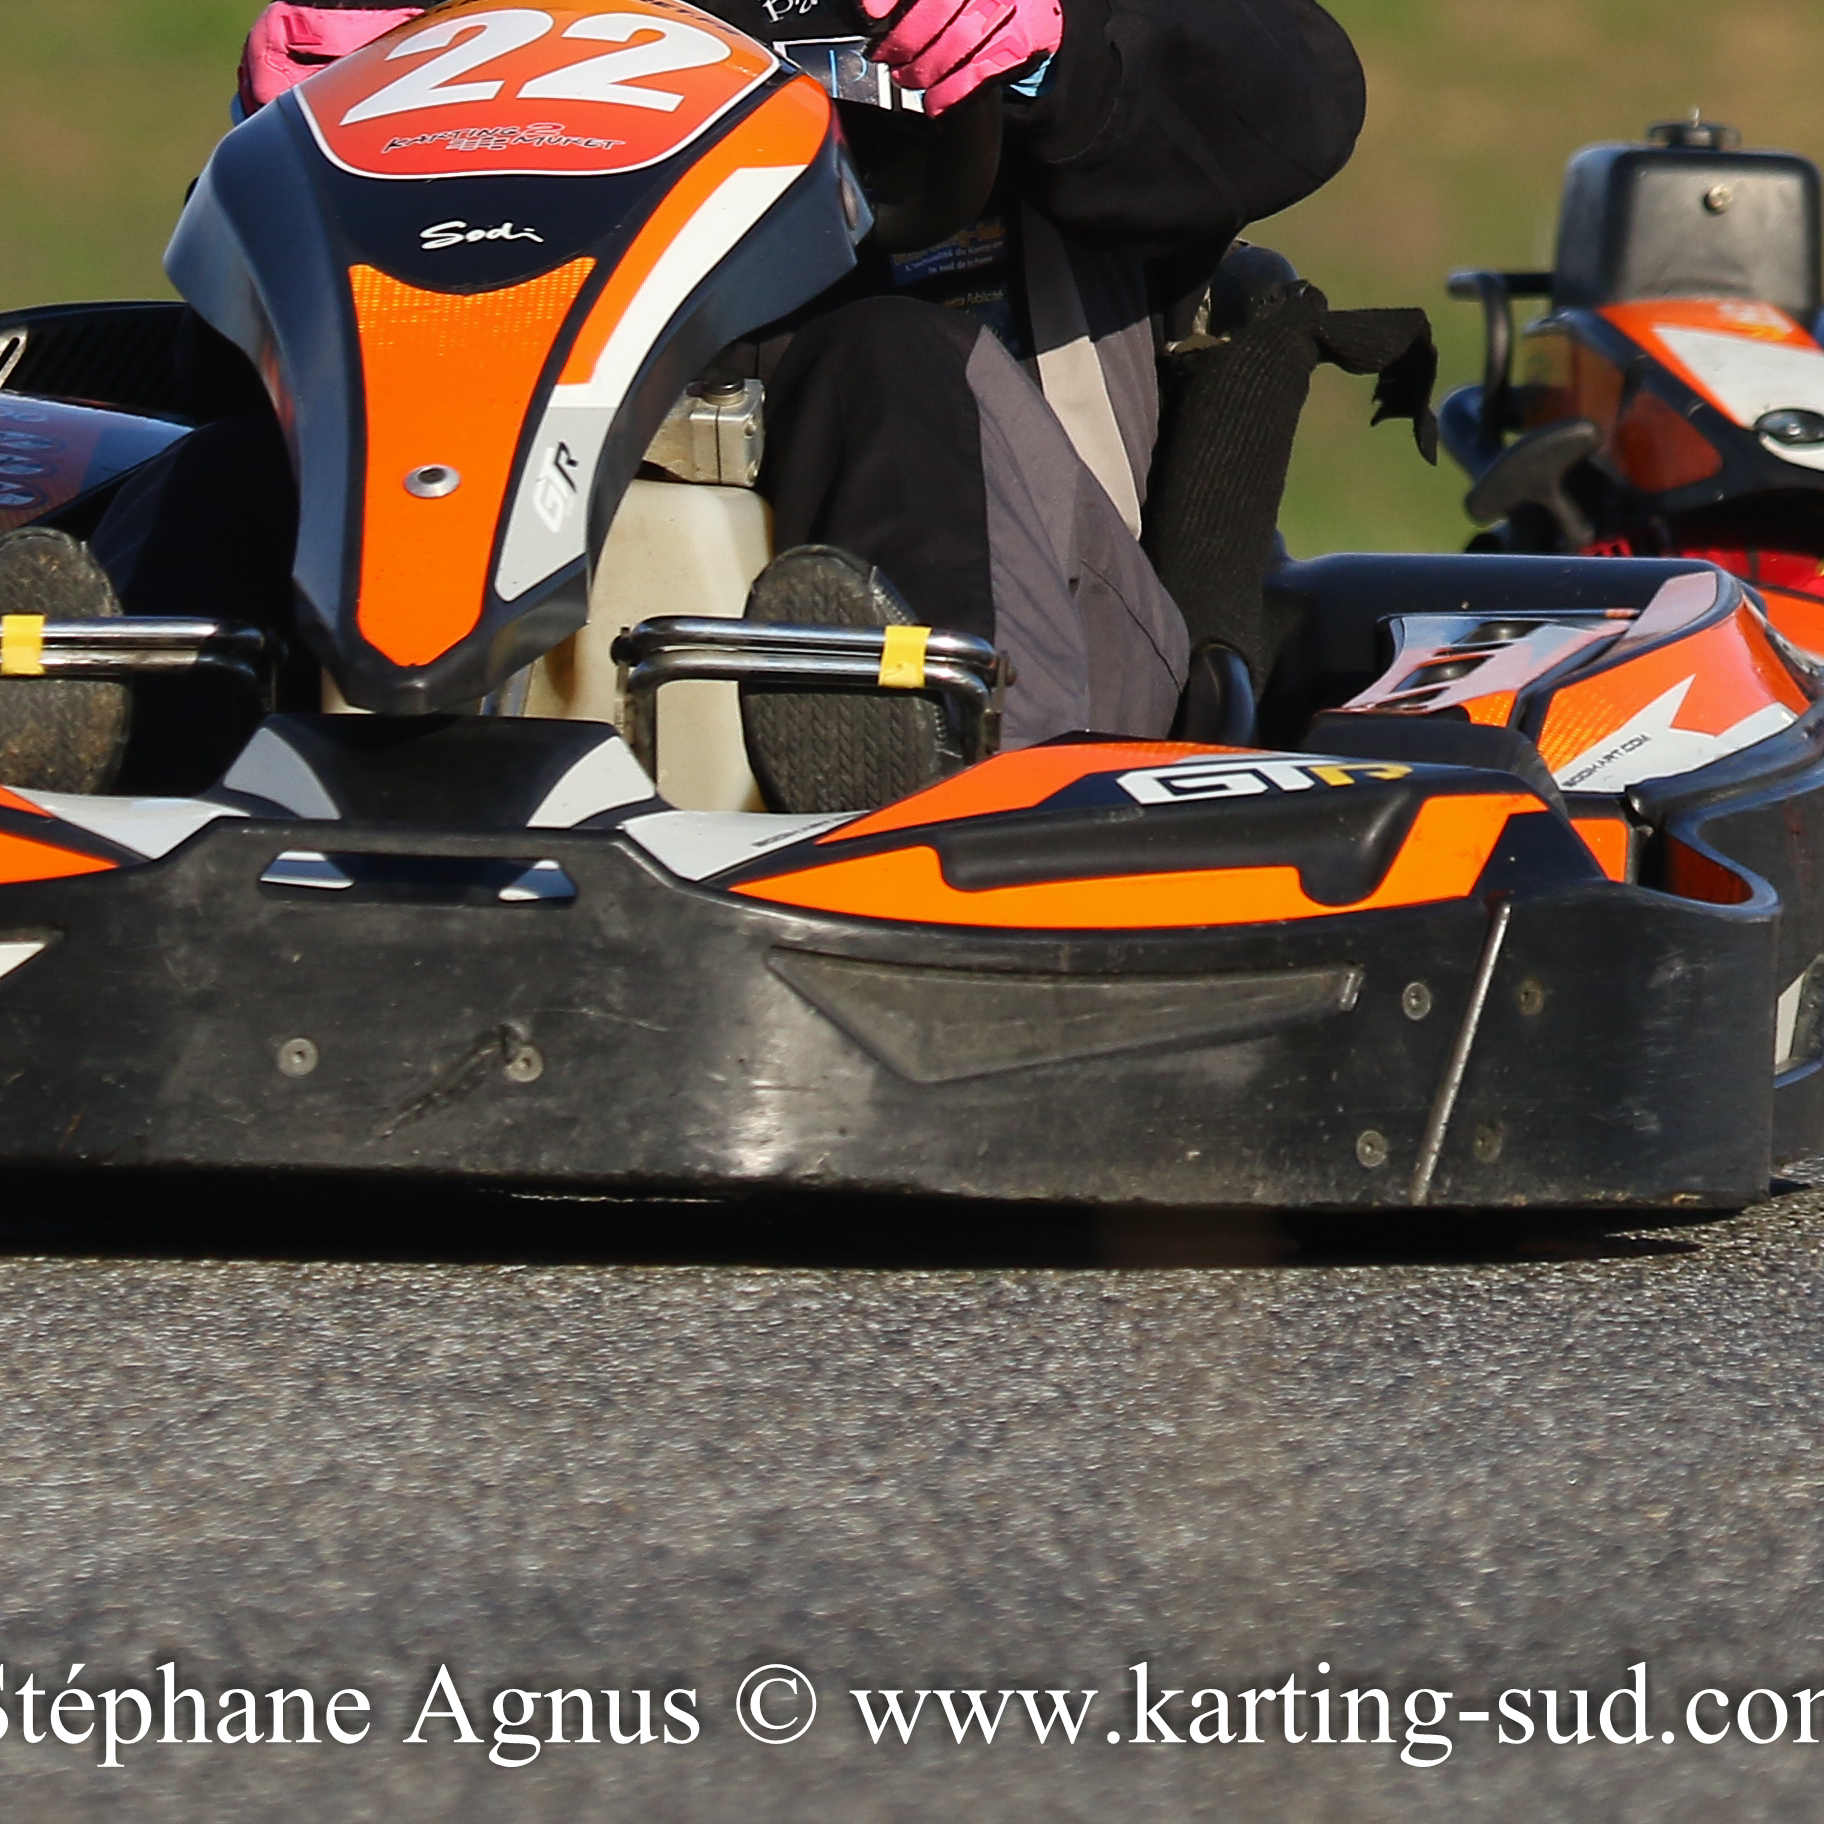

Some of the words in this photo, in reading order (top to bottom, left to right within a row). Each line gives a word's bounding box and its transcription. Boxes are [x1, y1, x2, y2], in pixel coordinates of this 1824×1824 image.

[338, 8, 733, 127] 22
[380, 126, 521, 153] KARTING
[419, 220, 546, 251] Sodi
[1116, 758, 1414, 806] GTR
